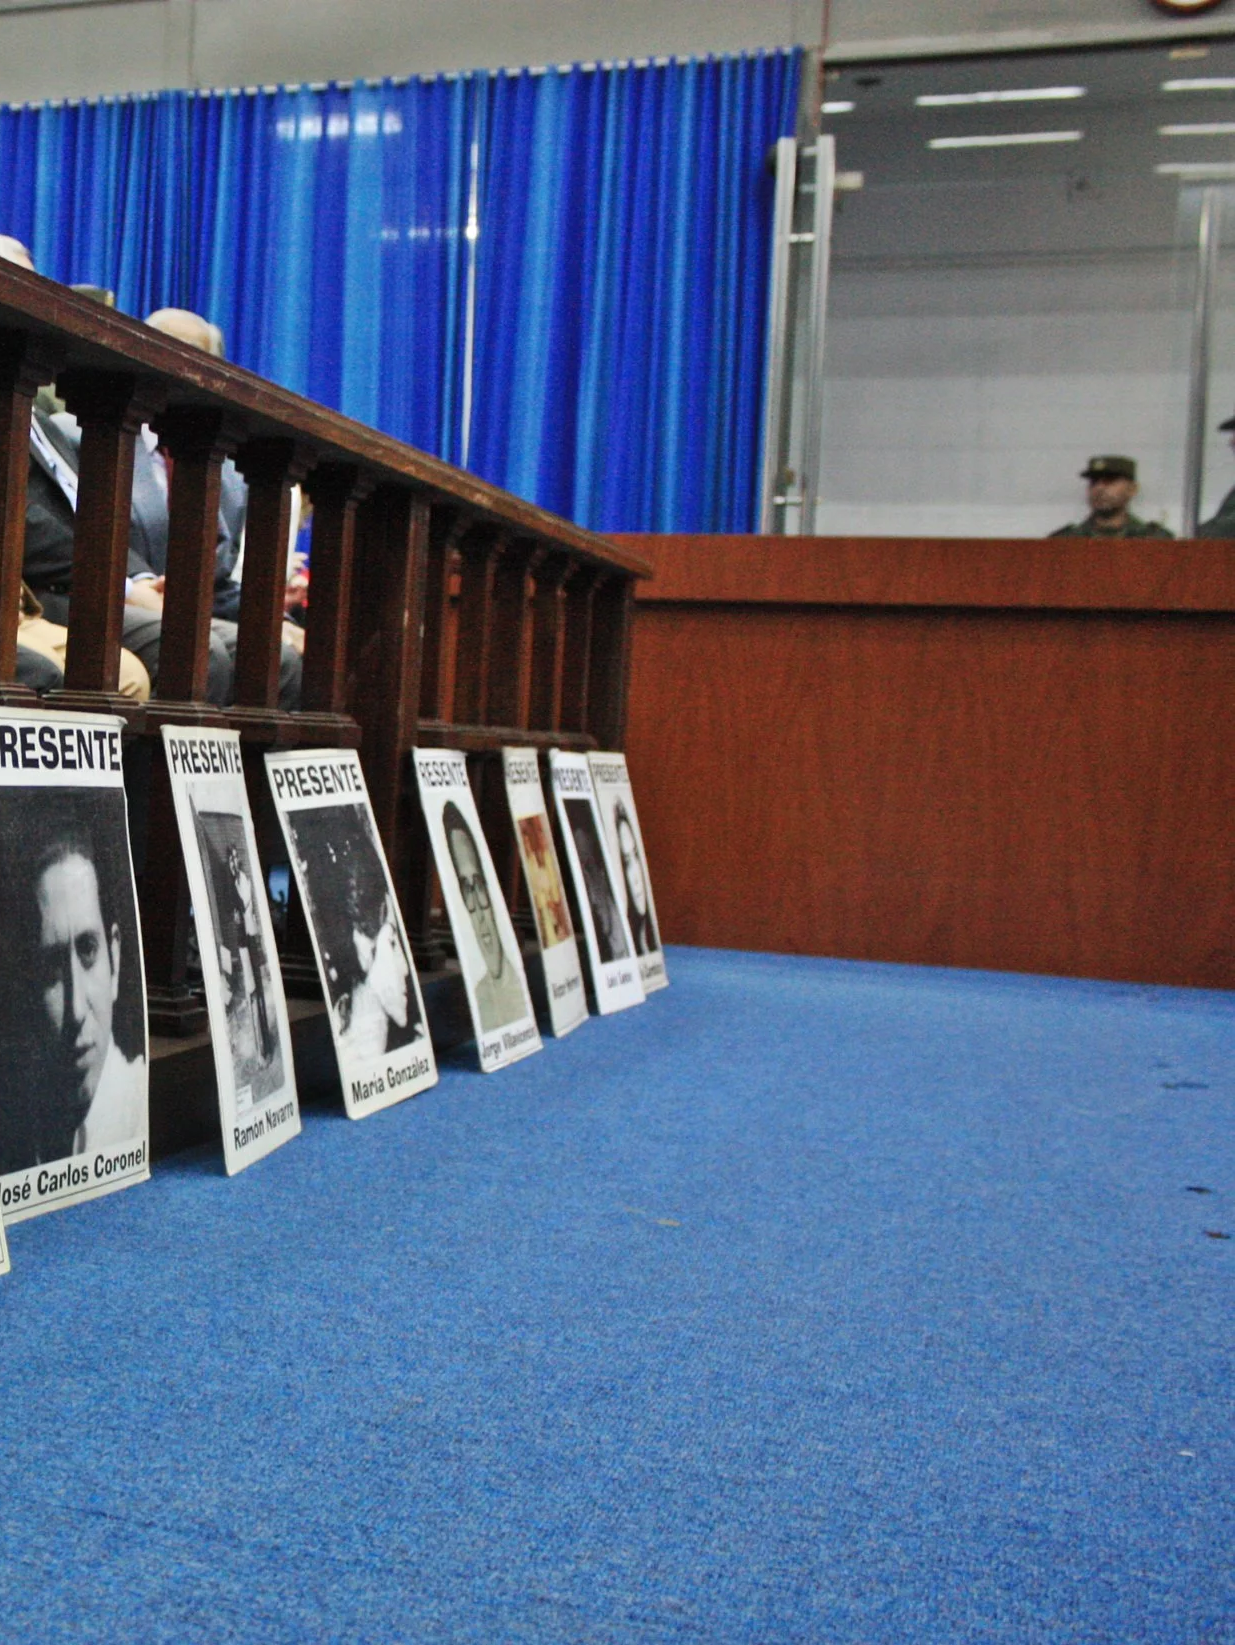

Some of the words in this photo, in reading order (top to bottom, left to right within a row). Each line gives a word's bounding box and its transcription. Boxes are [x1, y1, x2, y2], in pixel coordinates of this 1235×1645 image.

[169, 738, 242, 774] PRESENTE
[272, 764, 362, 799] PRESENTE
[351, 1071, 385, 1104] María
[386, 1056, 430, 1088] González
[233, 1115, 265, 1150] Ramón
[265, 1101, 295, 1132] Navarro
[37, 1163, 89, 1195] Carlos
[94, 1140, 146, 1178] Coronel
